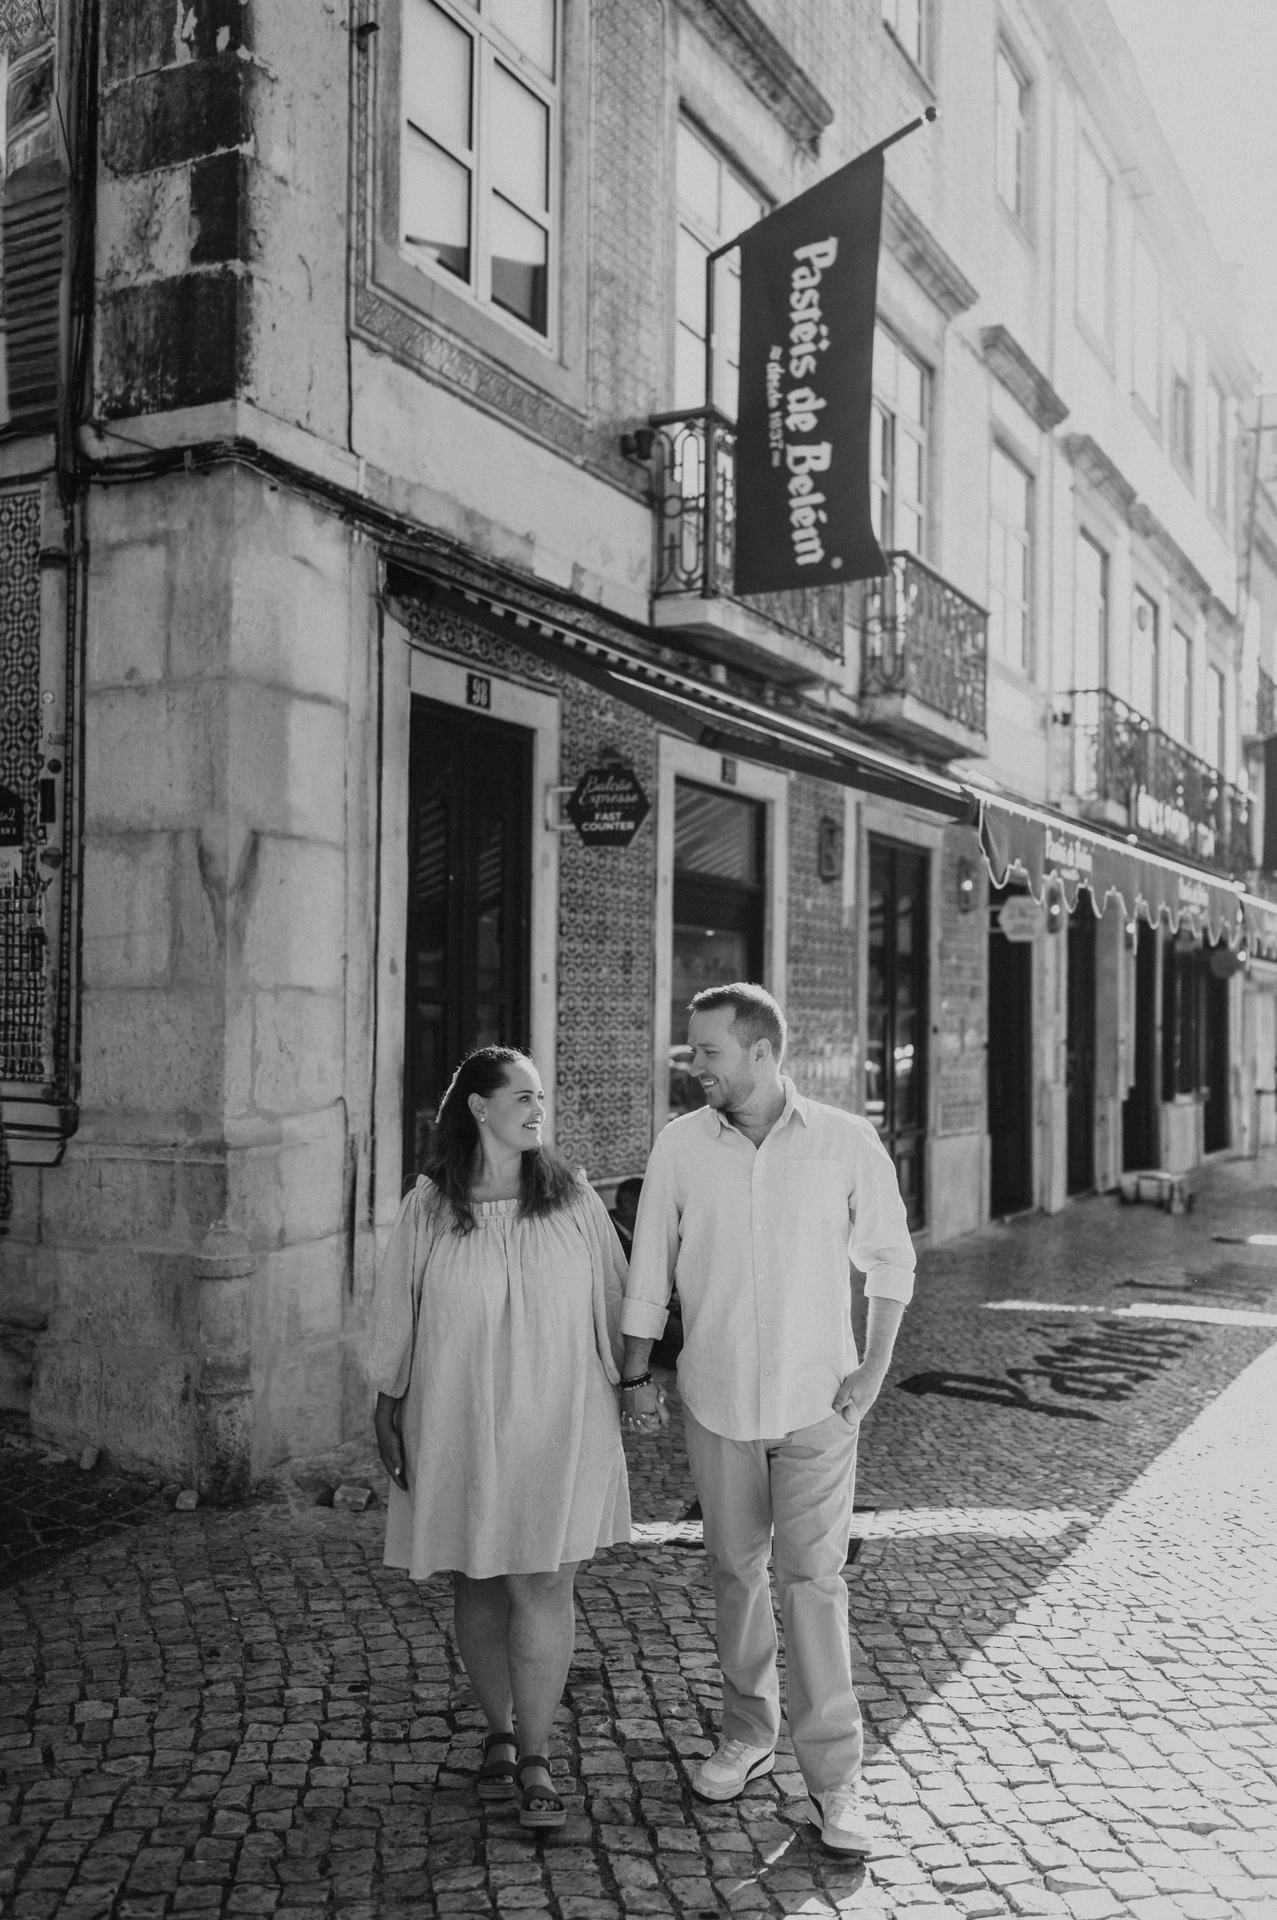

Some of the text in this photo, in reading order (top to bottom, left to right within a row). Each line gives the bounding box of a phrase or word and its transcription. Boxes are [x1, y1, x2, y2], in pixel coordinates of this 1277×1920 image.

[785, 236, 838, 566] Pastéis de Belém
[472, 678, 487, 706] 98
[595, 811, 623, 822] FAST
[581, 821, 635, 832] COUNTER
